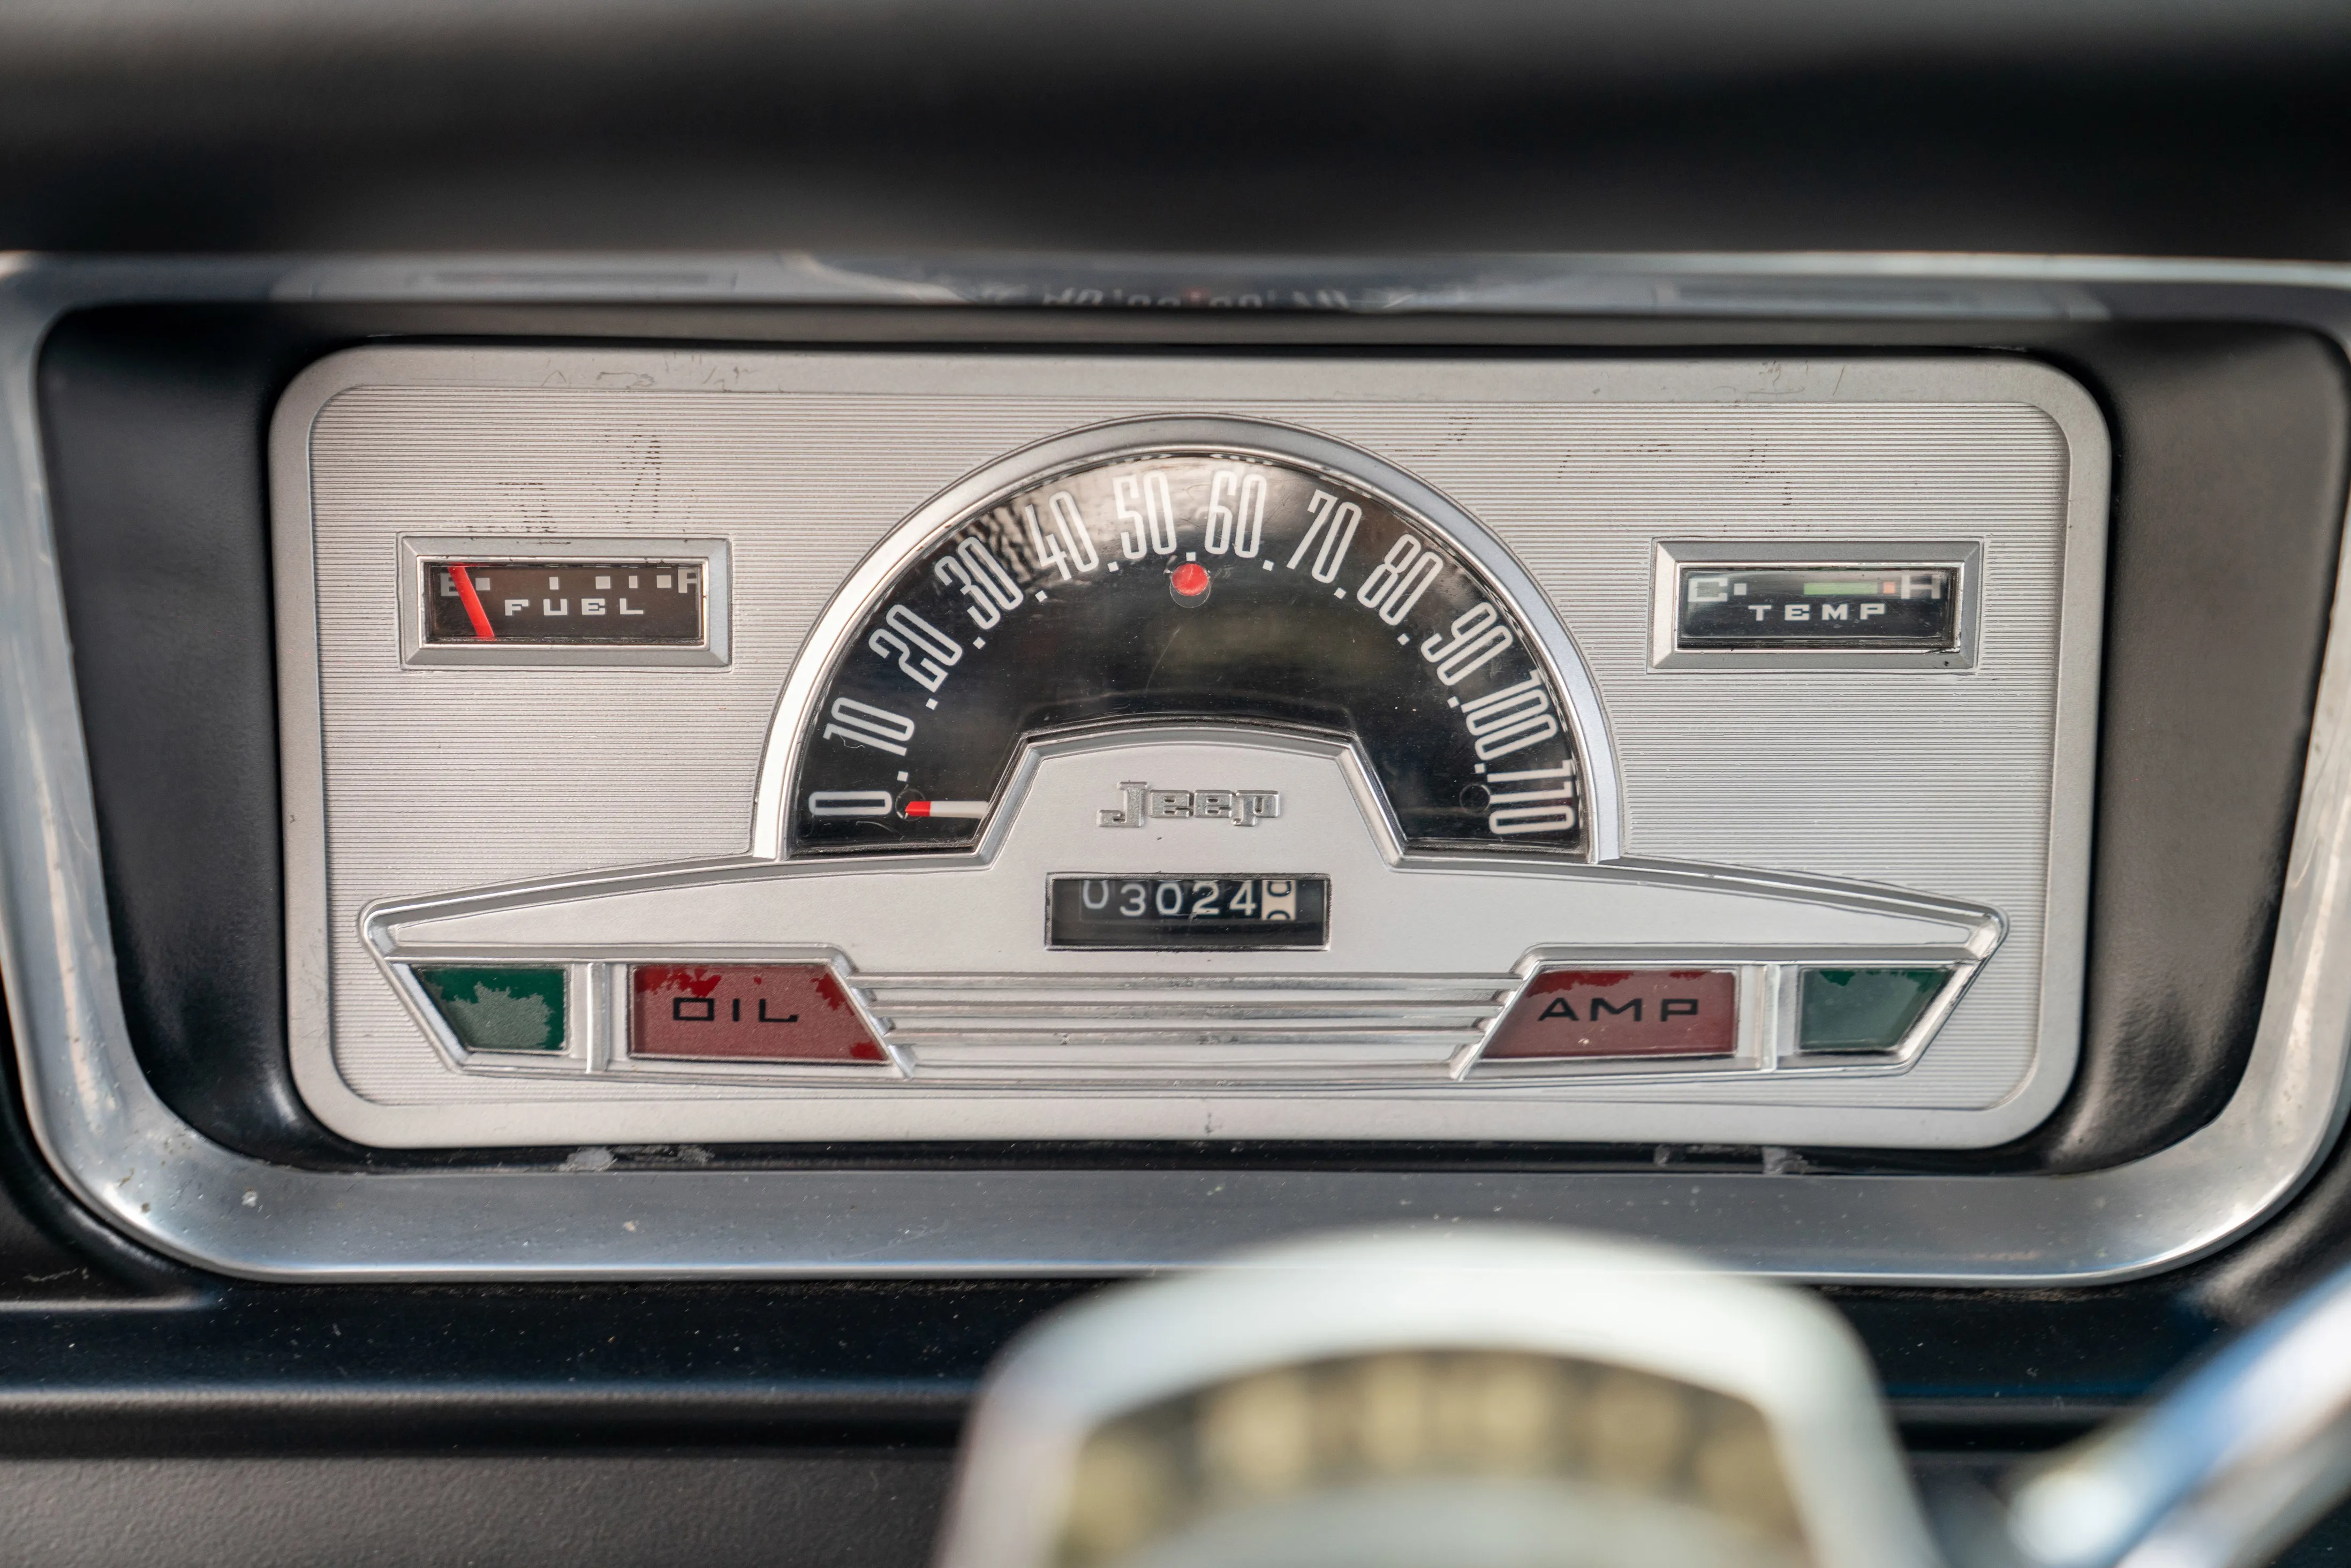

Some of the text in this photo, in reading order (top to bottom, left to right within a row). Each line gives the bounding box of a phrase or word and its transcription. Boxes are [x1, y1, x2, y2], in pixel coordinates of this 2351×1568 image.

[1024, 490, 1099, 581] 40
[1113, 471, 1177, 559] 50
[1204, 470, 1267, 558] 60
[1287, 489, 1363, 584] 70
[504, 598, 644, 616] FUEL
[934, 536, 1024, 631] 30
[1357, 534, 1444, 626] 80
[1688, 578, 1729, 602] C
[1748, 603, 1886, 622] TEMP
[1901, 574, 1941, 600] H
[868, 604, 963, 693] 20
[1420, 602, 1514, 686] 90
[823, 696, 916, 757] 10
[1461, 669, 1558, 760] 100
[808, 791, 893, 817] 0
[1097, 781, 1281, 828] Jeep
[1487, 760, 1576, 835] 110
[673, 997, 798, 1022] OIL
[1537, 997, 1699, 1022] AMP
